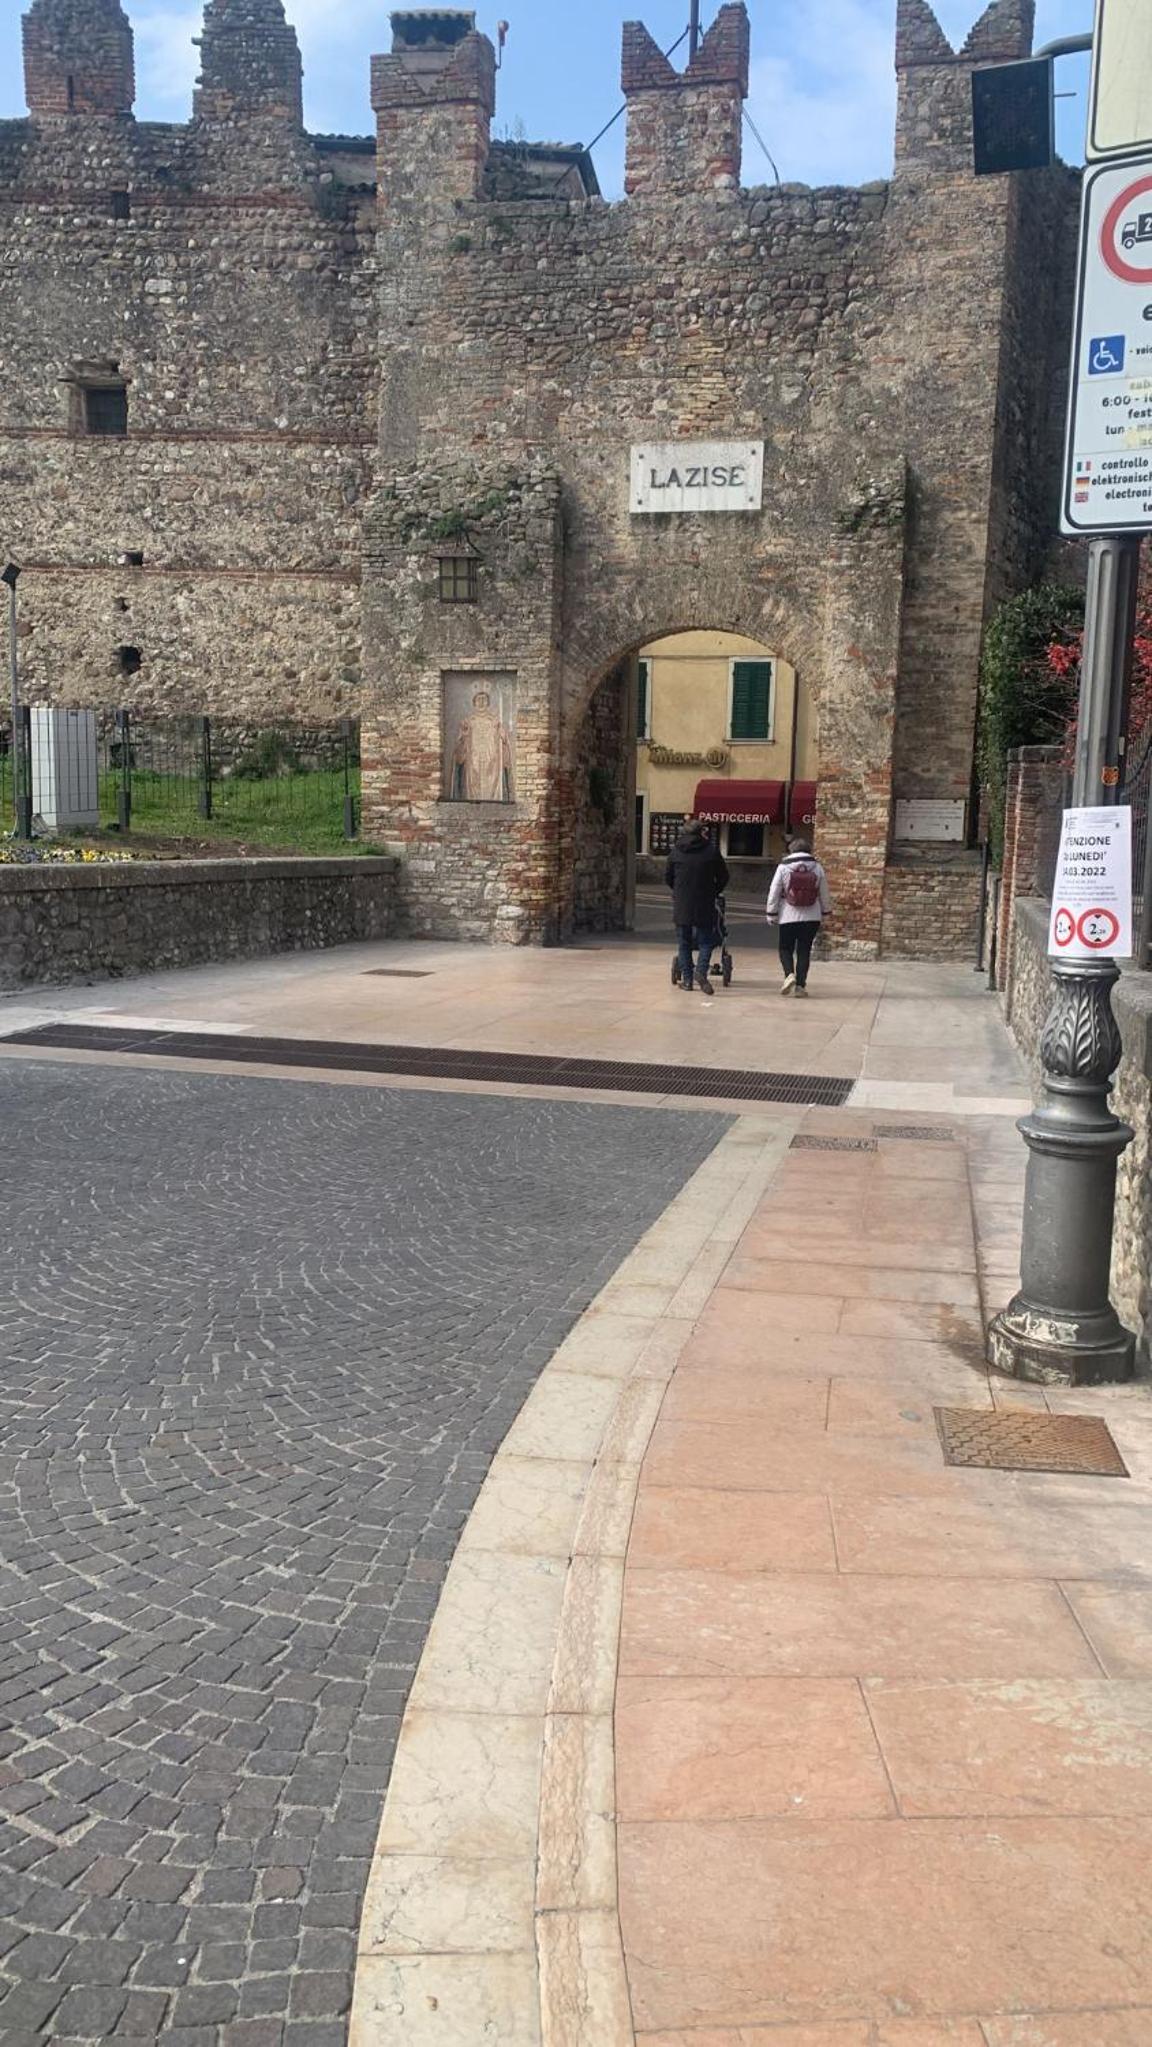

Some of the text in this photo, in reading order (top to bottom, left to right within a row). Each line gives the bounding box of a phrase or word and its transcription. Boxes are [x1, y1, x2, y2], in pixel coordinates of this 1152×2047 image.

[1102, 395, 1131, 407] 6:00
[1105, 425, 1125, 435] lun
[1101, 457, 1149, 470] controllo
[650, 466, 745, 488] LAZISE
[698, 811, 771, 824] PASTICCERIA
